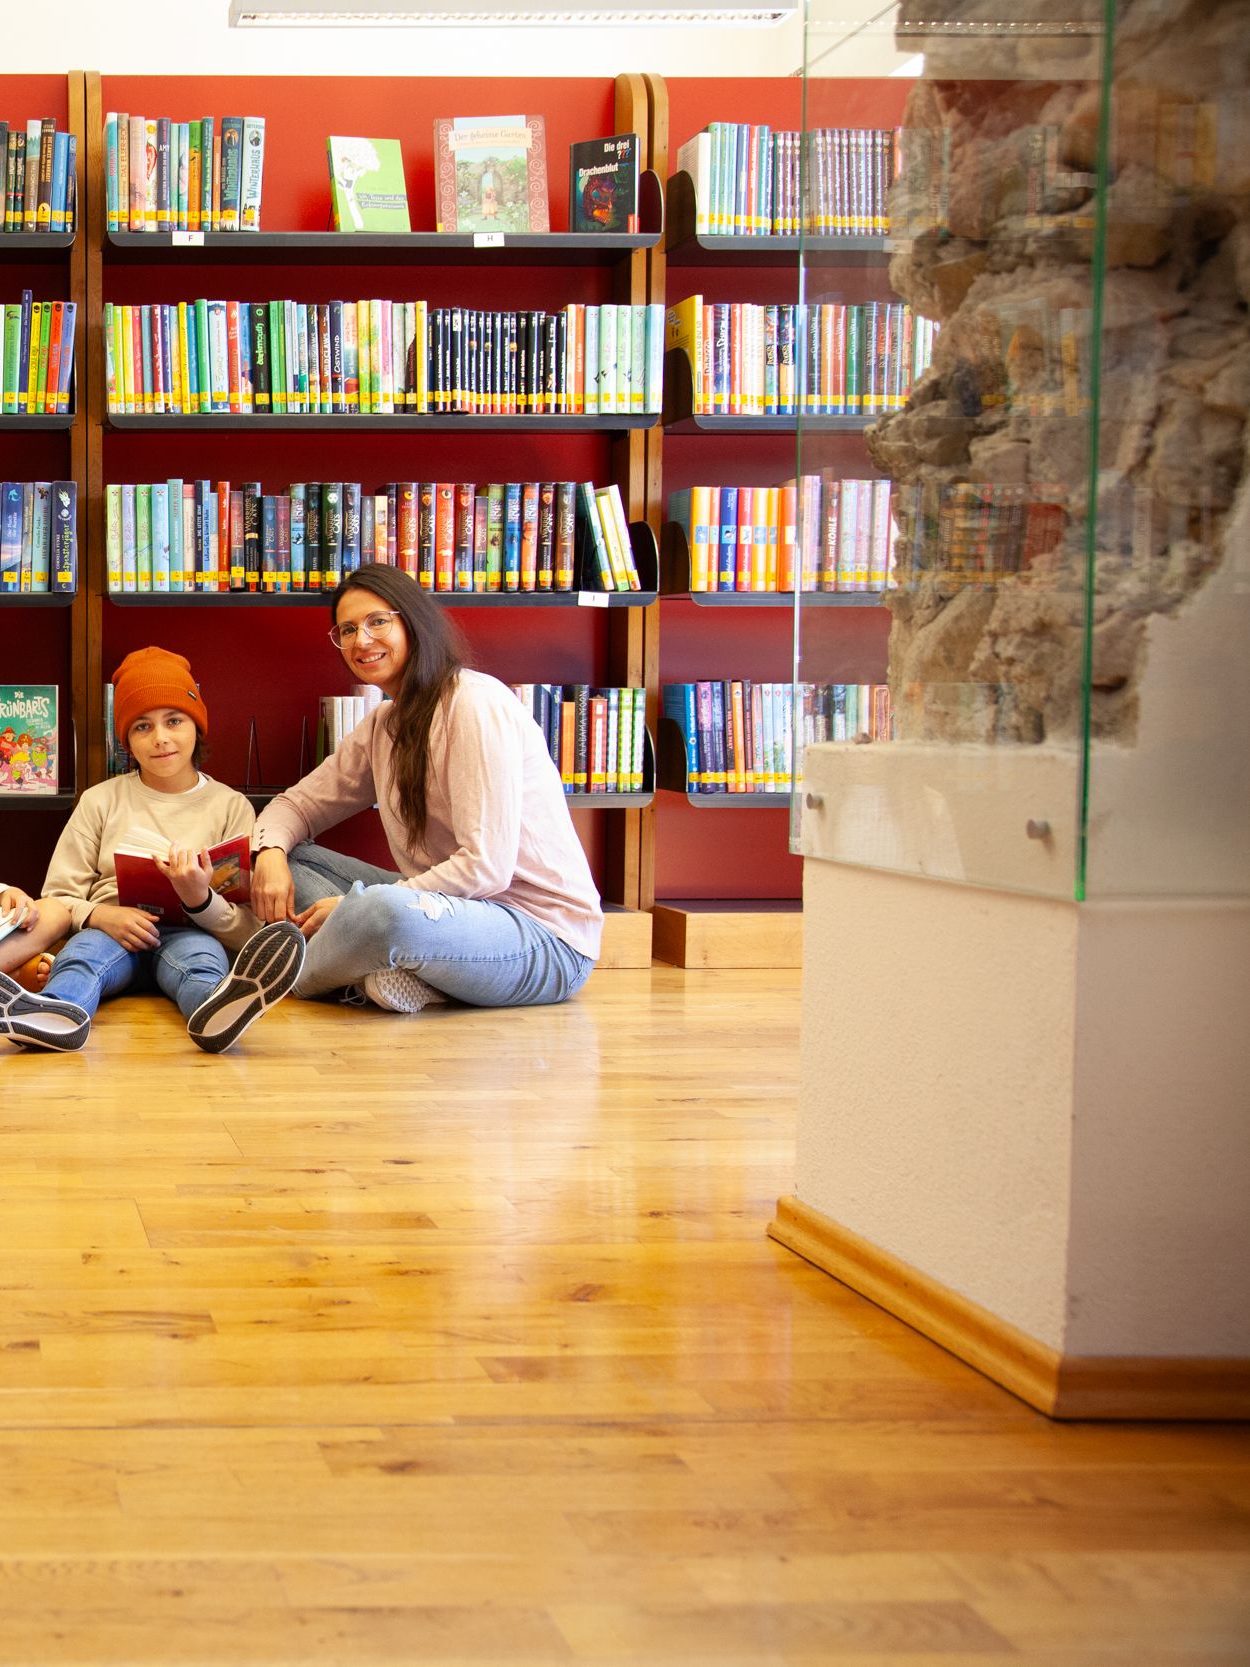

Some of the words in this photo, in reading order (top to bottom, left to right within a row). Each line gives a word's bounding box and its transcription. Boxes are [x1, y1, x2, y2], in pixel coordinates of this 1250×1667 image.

[500, 131, 527, 140] Garten
[604, 142, 615, 152] Die
[616, 139, 629, 150] drei
[617, 148, 631, 159] ???
[223, 148, 239, 201] WINTERHAUS
[246, 148, 261, 199] WINTERHAUS
[579, 161, 619, 177] Drachenblut
[322, 333, 330, 358] CLAWS
[333, 335, 341, 374] OSTWIND
[407, 517, 416, 543] CATS
[445, 517, 454, 543] CATS
[827, 516, 836, 546] KOHLE
[61, 524, 72, 573] espensterjäger
[14, 691, 24, 699] DIE
[578, 690, 587, 715] MOON
[578, 719, 586, 757] ALABAMA
